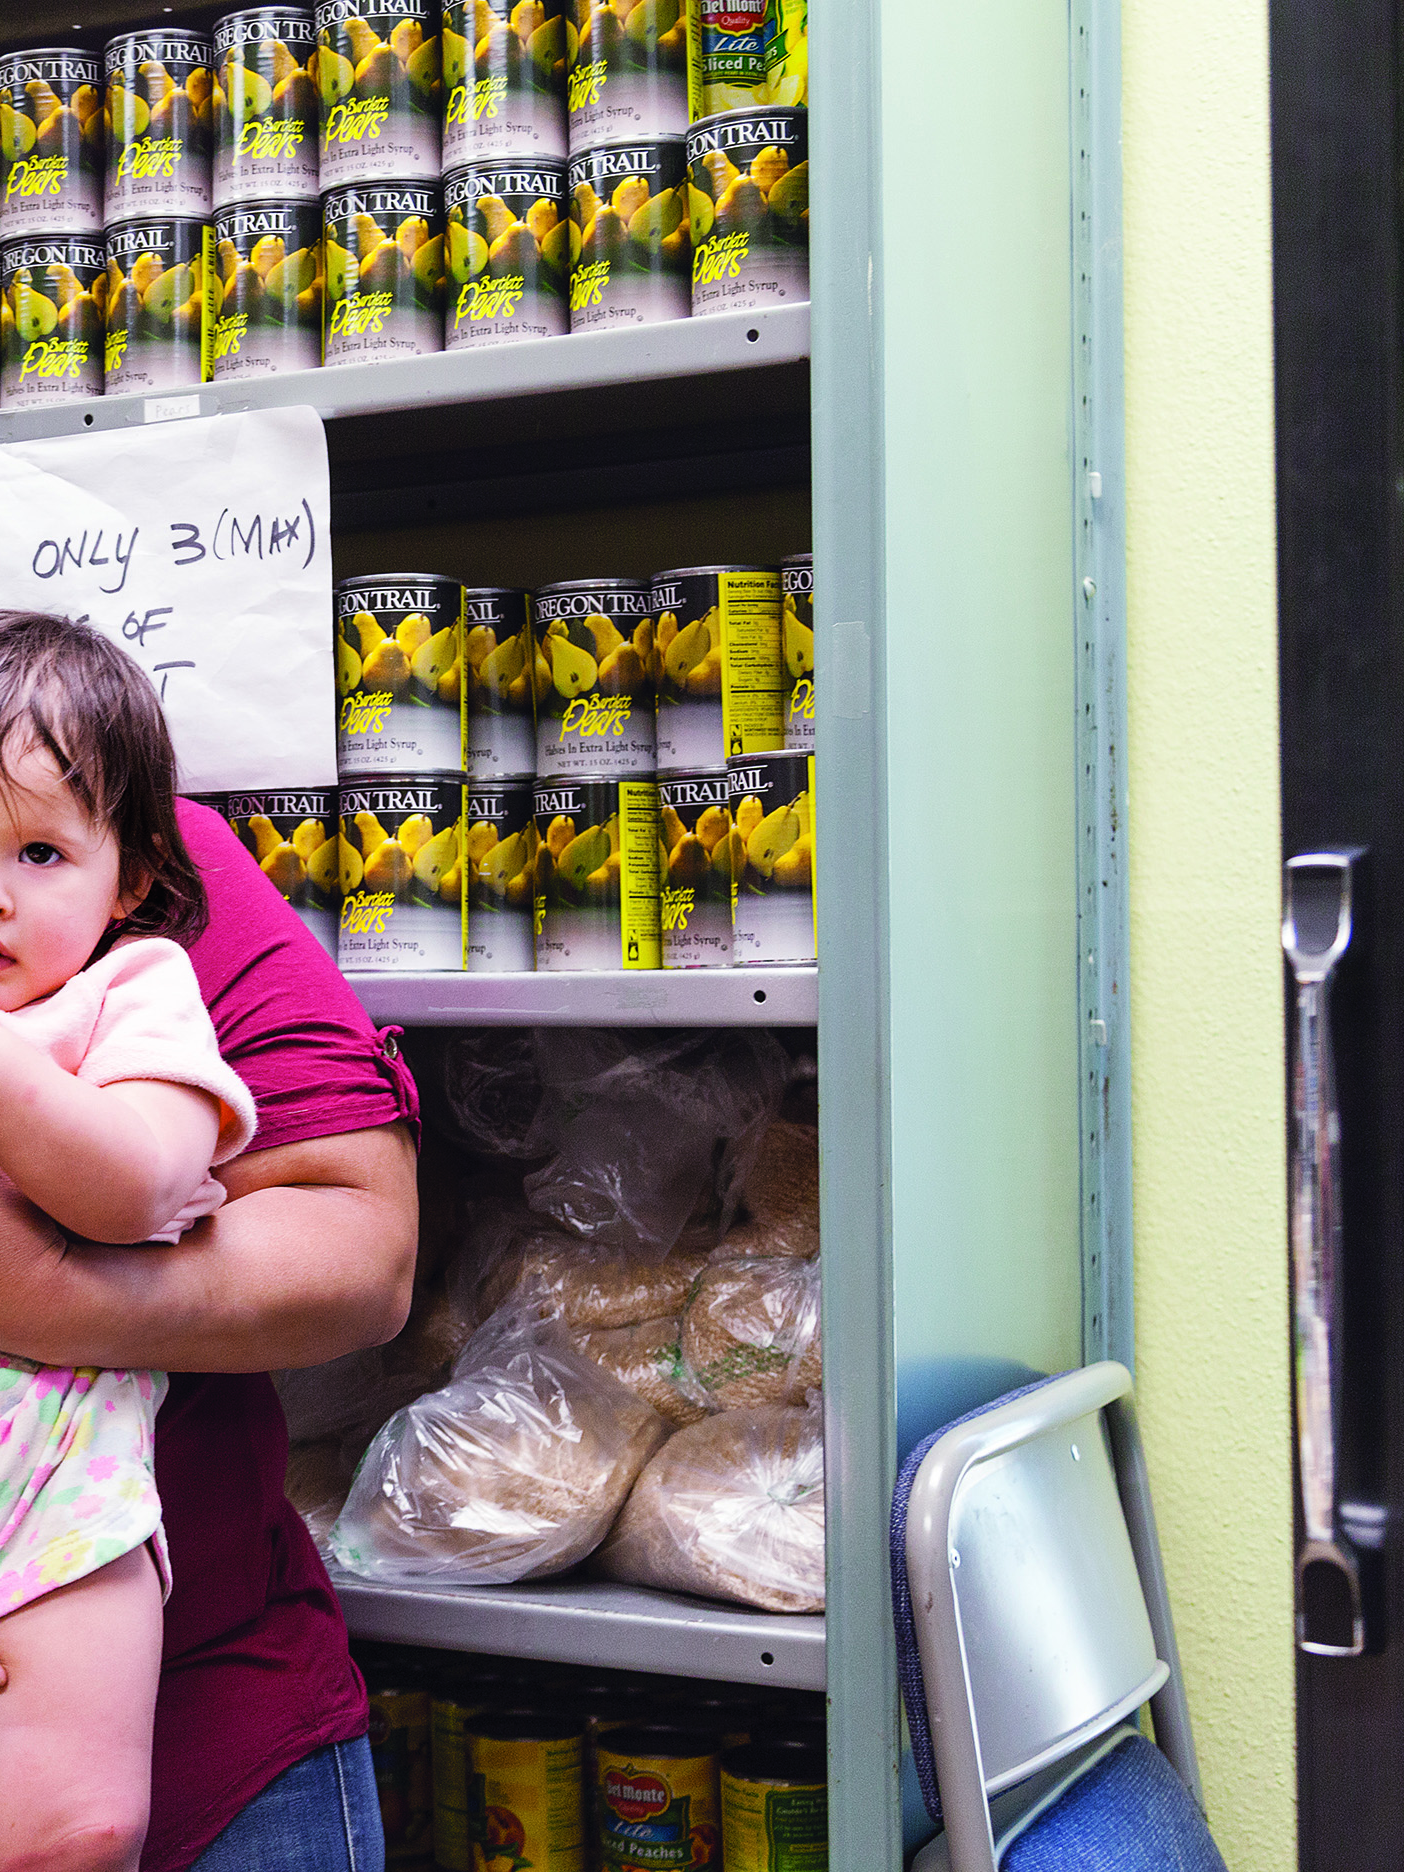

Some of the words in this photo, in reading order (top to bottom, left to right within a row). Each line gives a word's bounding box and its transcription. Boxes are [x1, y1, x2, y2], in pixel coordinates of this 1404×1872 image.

[714, 36, 759, 52] Lite
[347, 95, 390, 114] Bartlett
[445, 86, 507, 134] Pears
[606, 106, 634, 120] Syrup
[263, 116, 305, 133] Bartlett
[325, 104, 389, 152] Pears
[479, 124, 503, 136] Light
[506, 122, 533, 136] Syrup
[720, 121, 794, 146] TRAIL
[142, 136, 183, 152] Bartlett
[232, 122, 303, 166] Pears
[339, 149, 359, 161] Extra
[362, 146, 385, 159] Light
[388, 143, 414, 157] Syrup
[29, 154, 69, 171] Bartlett
[115, 142, 182, 187] Pears
[252, 164, 274, 176] Extra
[277, 163, 300, 177] Light
[587, 151, 656, 179] TRAIL
[5, 161, 68, 203] Pears
[180, 182, 204, 197] Syrup
[498, 173, 562, 195] TRAIL
[20, 202, 42, 213] Extra
[43, 200, 65, 213] Light
[67, 201, 92, 215] Syrup
[376, 191, 434, 213] TRAIL
[234, 212, 292, 236] TRAIL
[114, 229, 170, 252] TRAIL
[708, 231, 750, 252] Bartlett
[578, 259, 611, 280] Bartlett
[480, 274, 525, 293] Bartlett
[722, 280, 746, 297] Light
[749, 279, 778, 296] Syrup
[352, 290, 393, 309] Bartlett
[455, 281, 524, 329] Pears
[329, 299, 392, 344] Pears
[587, 310, 607, 323] Light
[609, 306, 637, 320] Syrup
[470, 325, 492, 338] Extra
[495, 323, 519, 336] Light
[521, 322, 548, 336] Syrup
[48, 336, 89, 353] Bartlett
[342, 341, 362, 354] Extra
[363, 338, 389, 352] Light
[390, 338, 416, 352] Syrup
[19, 342, 88, 383] Pears
[226, 359, 245, 372] Light
[246, 357, 271, 371] Syrup
[37, 382, 60, 393] Extra
[62, 380, 84, 395] Light
[126, 371, 148, 385] Syrup
[32, 527, 139, 594] ONLY
[727, 581, 765, 589] Nutrition
[370, 590, 436, 609] TRAIL
[122, 606, 174, 647] OF
[355, 690, 393, 709] Bartlett
[589, 693, 632, 711] Bartlett
[559, 698, 631, 742] Pears
[365, 738, 388, 751] Light
[391, 738, 417, 752] Syrup
[567, 743, 577, 754] In
[579, 742, 603, 754] Extra
[606, 741, 629, 754] Light
[268, 795, 331, 815] TRAIL
[373, 790, 438, 811] TRAIL
[355, 890, 396, 908] Bartlett
[368, 939, 390, 952] Light
[392, 938, 419, 952] Syrup
[673, 933, 692, 947] Light
[694, 935, 721, 947] Syrup
[622, 1784, 666, 1804] Monte
[629, 1839, 684, 1860] Peaches
